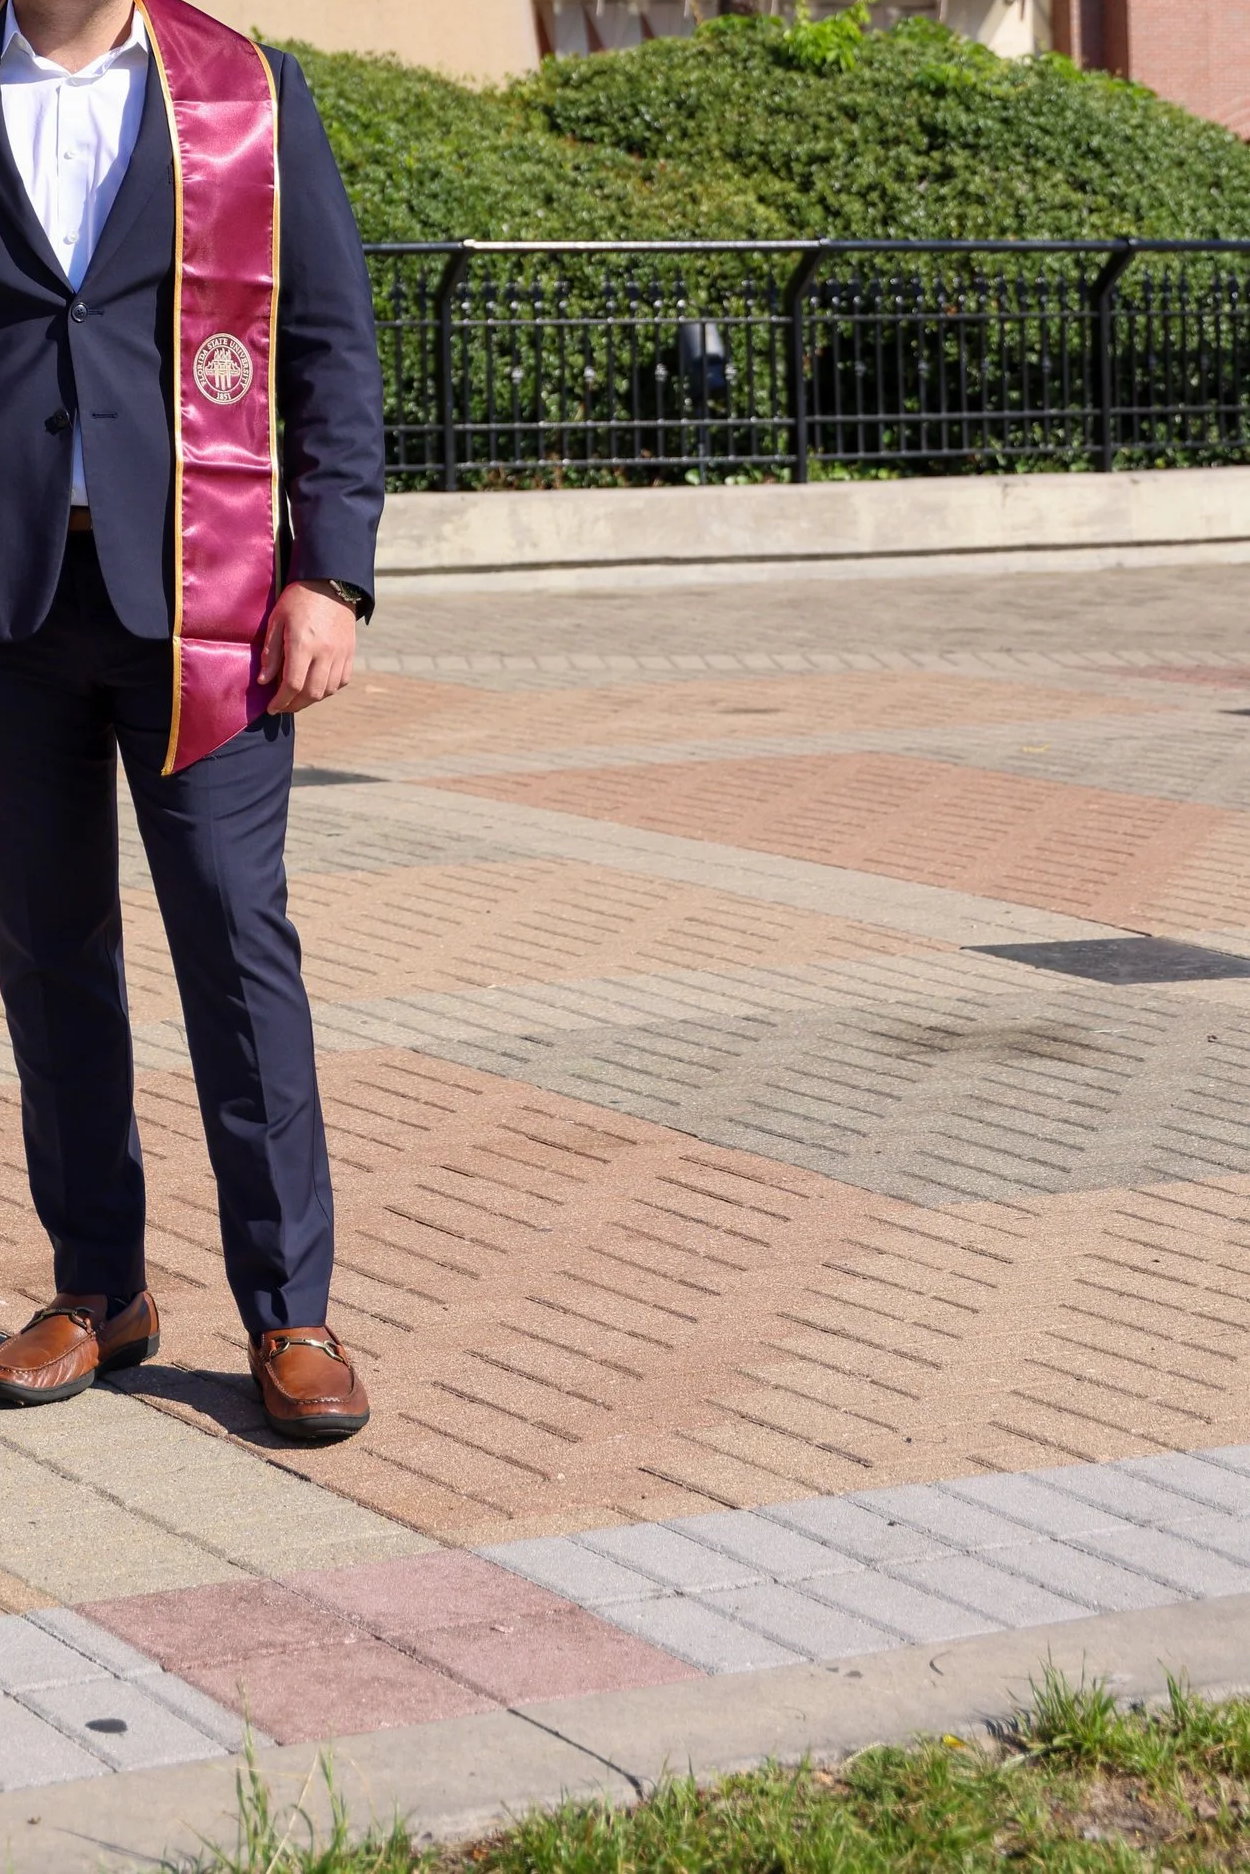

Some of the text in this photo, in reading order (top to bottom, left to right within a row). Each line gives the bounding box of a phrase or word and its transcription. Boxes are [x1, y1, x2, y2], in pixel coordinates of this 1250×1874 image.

[196, 337, 250, 388] FLORIDA STATE UNIVERSITY
[216, 392, 232, 400] 1851
